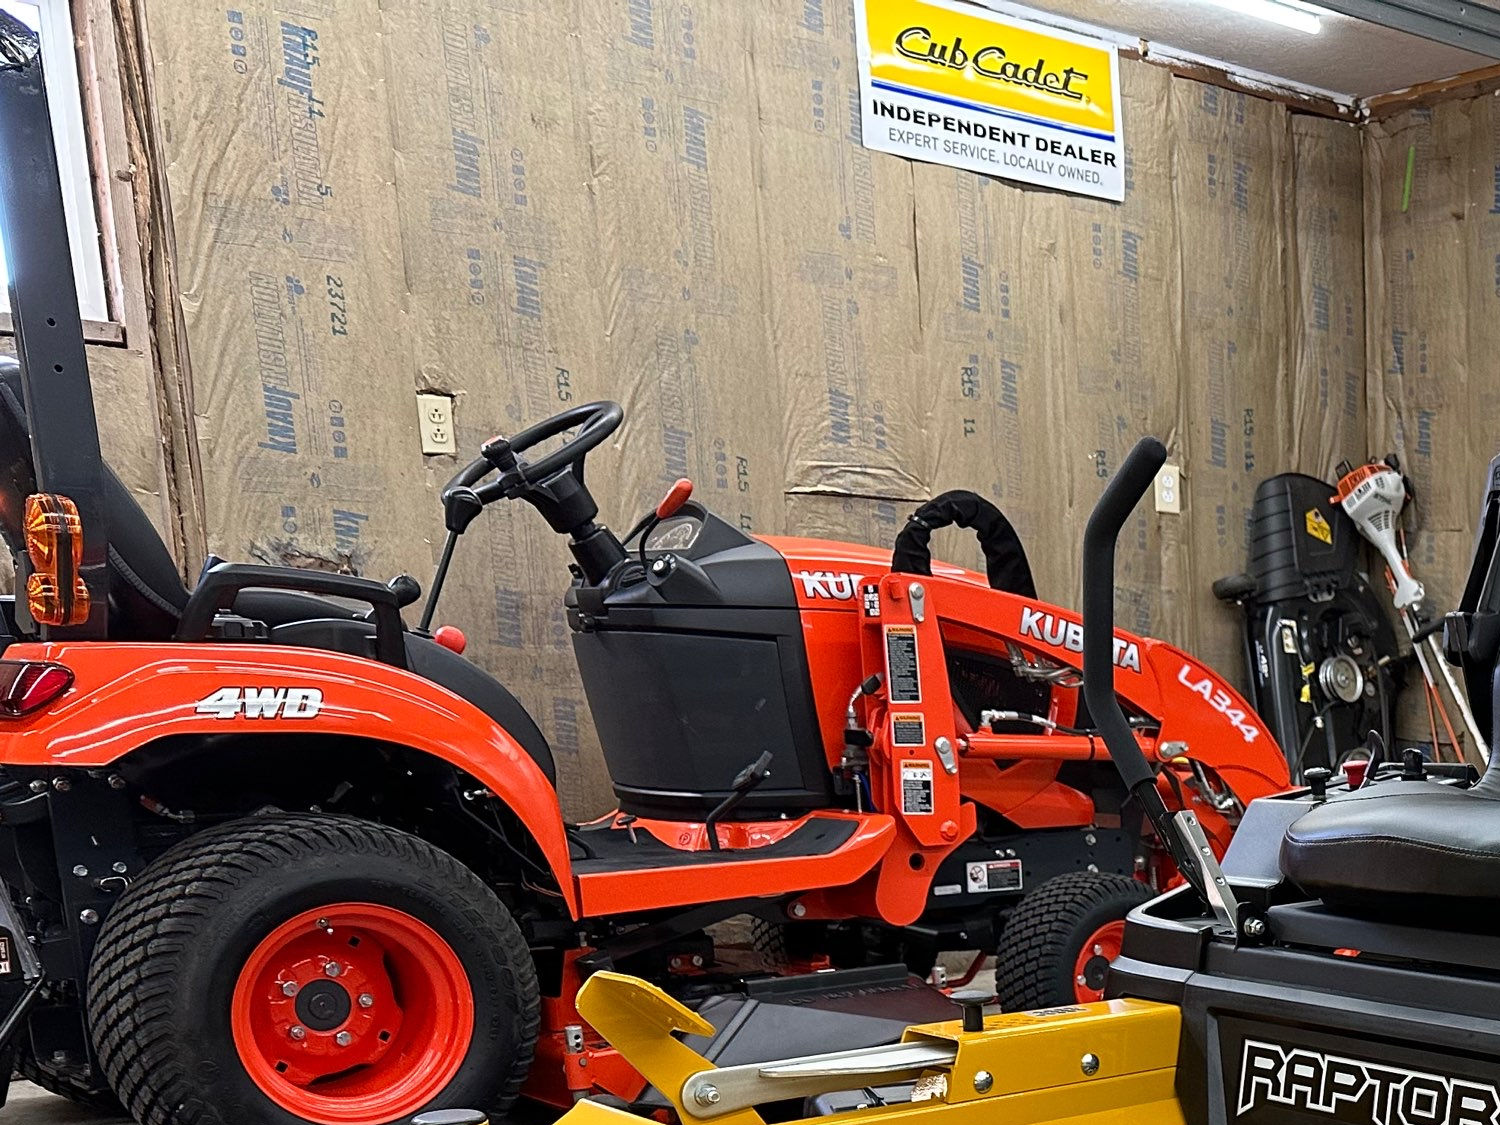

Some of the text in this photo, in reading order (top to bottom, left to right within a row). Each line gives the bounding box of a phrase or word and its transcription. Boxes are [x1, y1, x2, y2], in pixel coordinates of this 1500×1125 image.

[895, 26, 1088, 101] Cub Cadet
[277, 21, 326, 212] KNAUF INSULATION
[679, 104, 714, 172] KNAUF
[872, 99, 1117, 168] INDEPENDENT DEALER
[447, 128, 485, 198] KNAUF
[889, 128, 1105, 186] EXPERT SERVICE. LOCALLY OWNED.
[955, 254, 984, 314] KNAUF
[1119, 229, 1144, 283] KNAUF
[325, 274, 348, 337] 23721
[513, 254, 549, 320] KNAUF
[249, 270, 301, 455] KNAUF INSULATION
[555, 366, 573, 402] R15
[960, 365, 974, 398] R15
[999, 358, 1022, 415] KNAUF
[824, 387, 854, 446] KNAUF
[1206, 416, 1230, 469] KNAUF
[1243, 408, 1255, 436] R15
[1415, 409, 1436, 458] KNAUF
[736, 456, 750, 492] R15
[1095, 449, 1108, 479] R15
[1020, 606, 1140, 673] KUBTA
[1177, 664, 1259, 742] LA344
